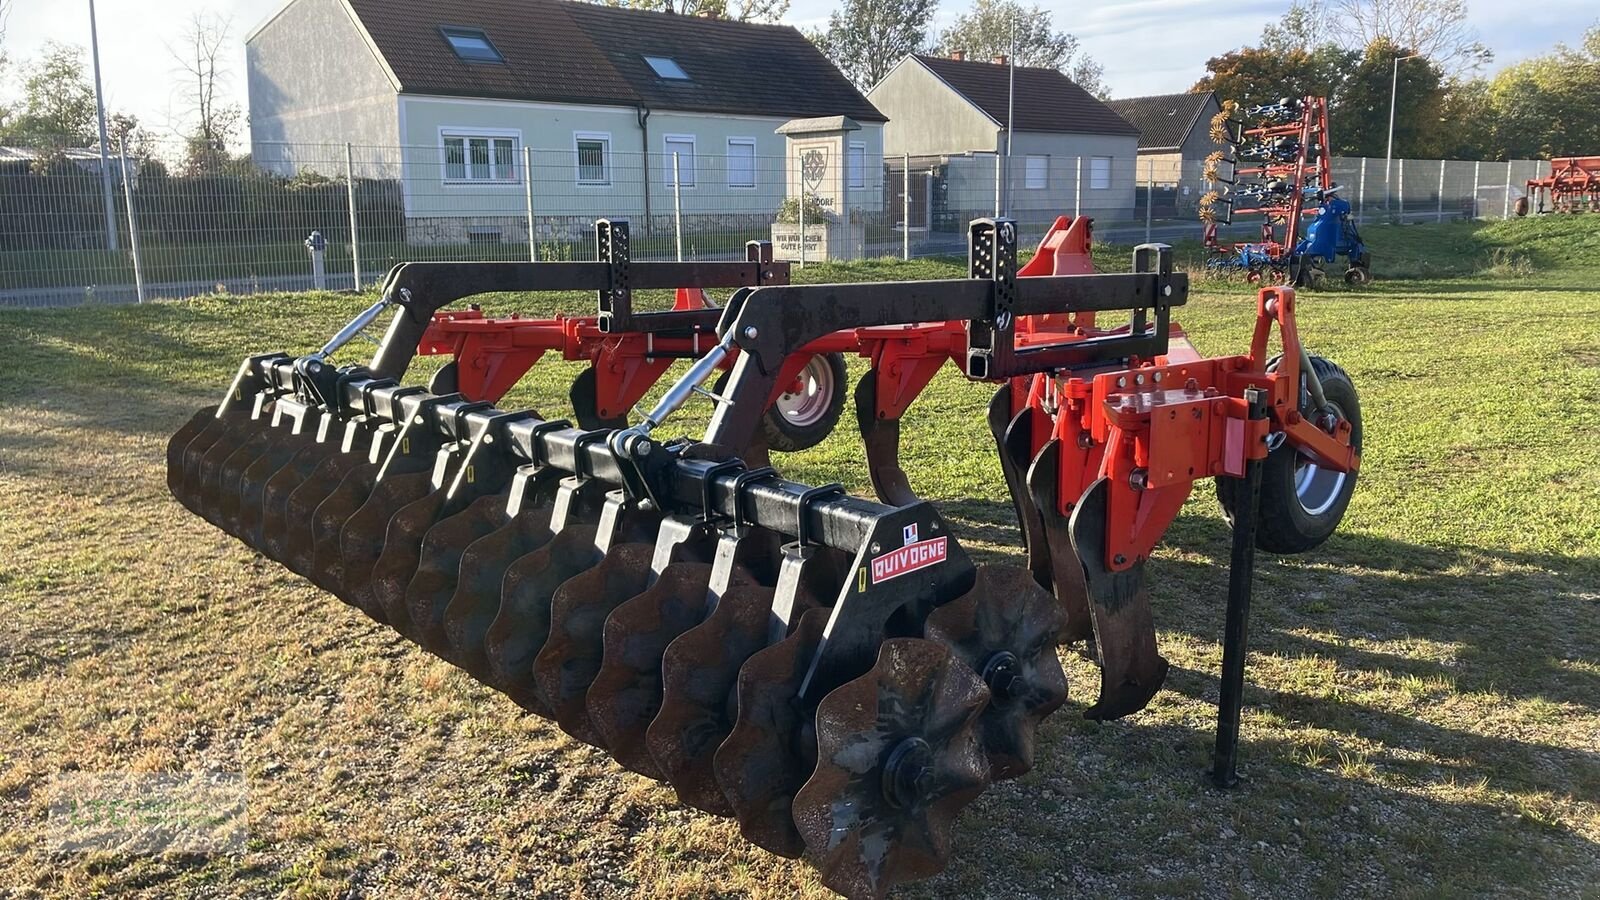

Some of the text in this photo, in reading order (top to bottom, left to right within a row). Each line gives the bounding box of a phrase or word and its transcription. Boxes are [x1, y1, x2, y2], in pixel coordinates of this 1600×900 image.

[788, 233, 822, 242] WÜCHEN
[798, 243, 817, 251] FHRT
[875, 541, 945, 577] QUIVOGNE
